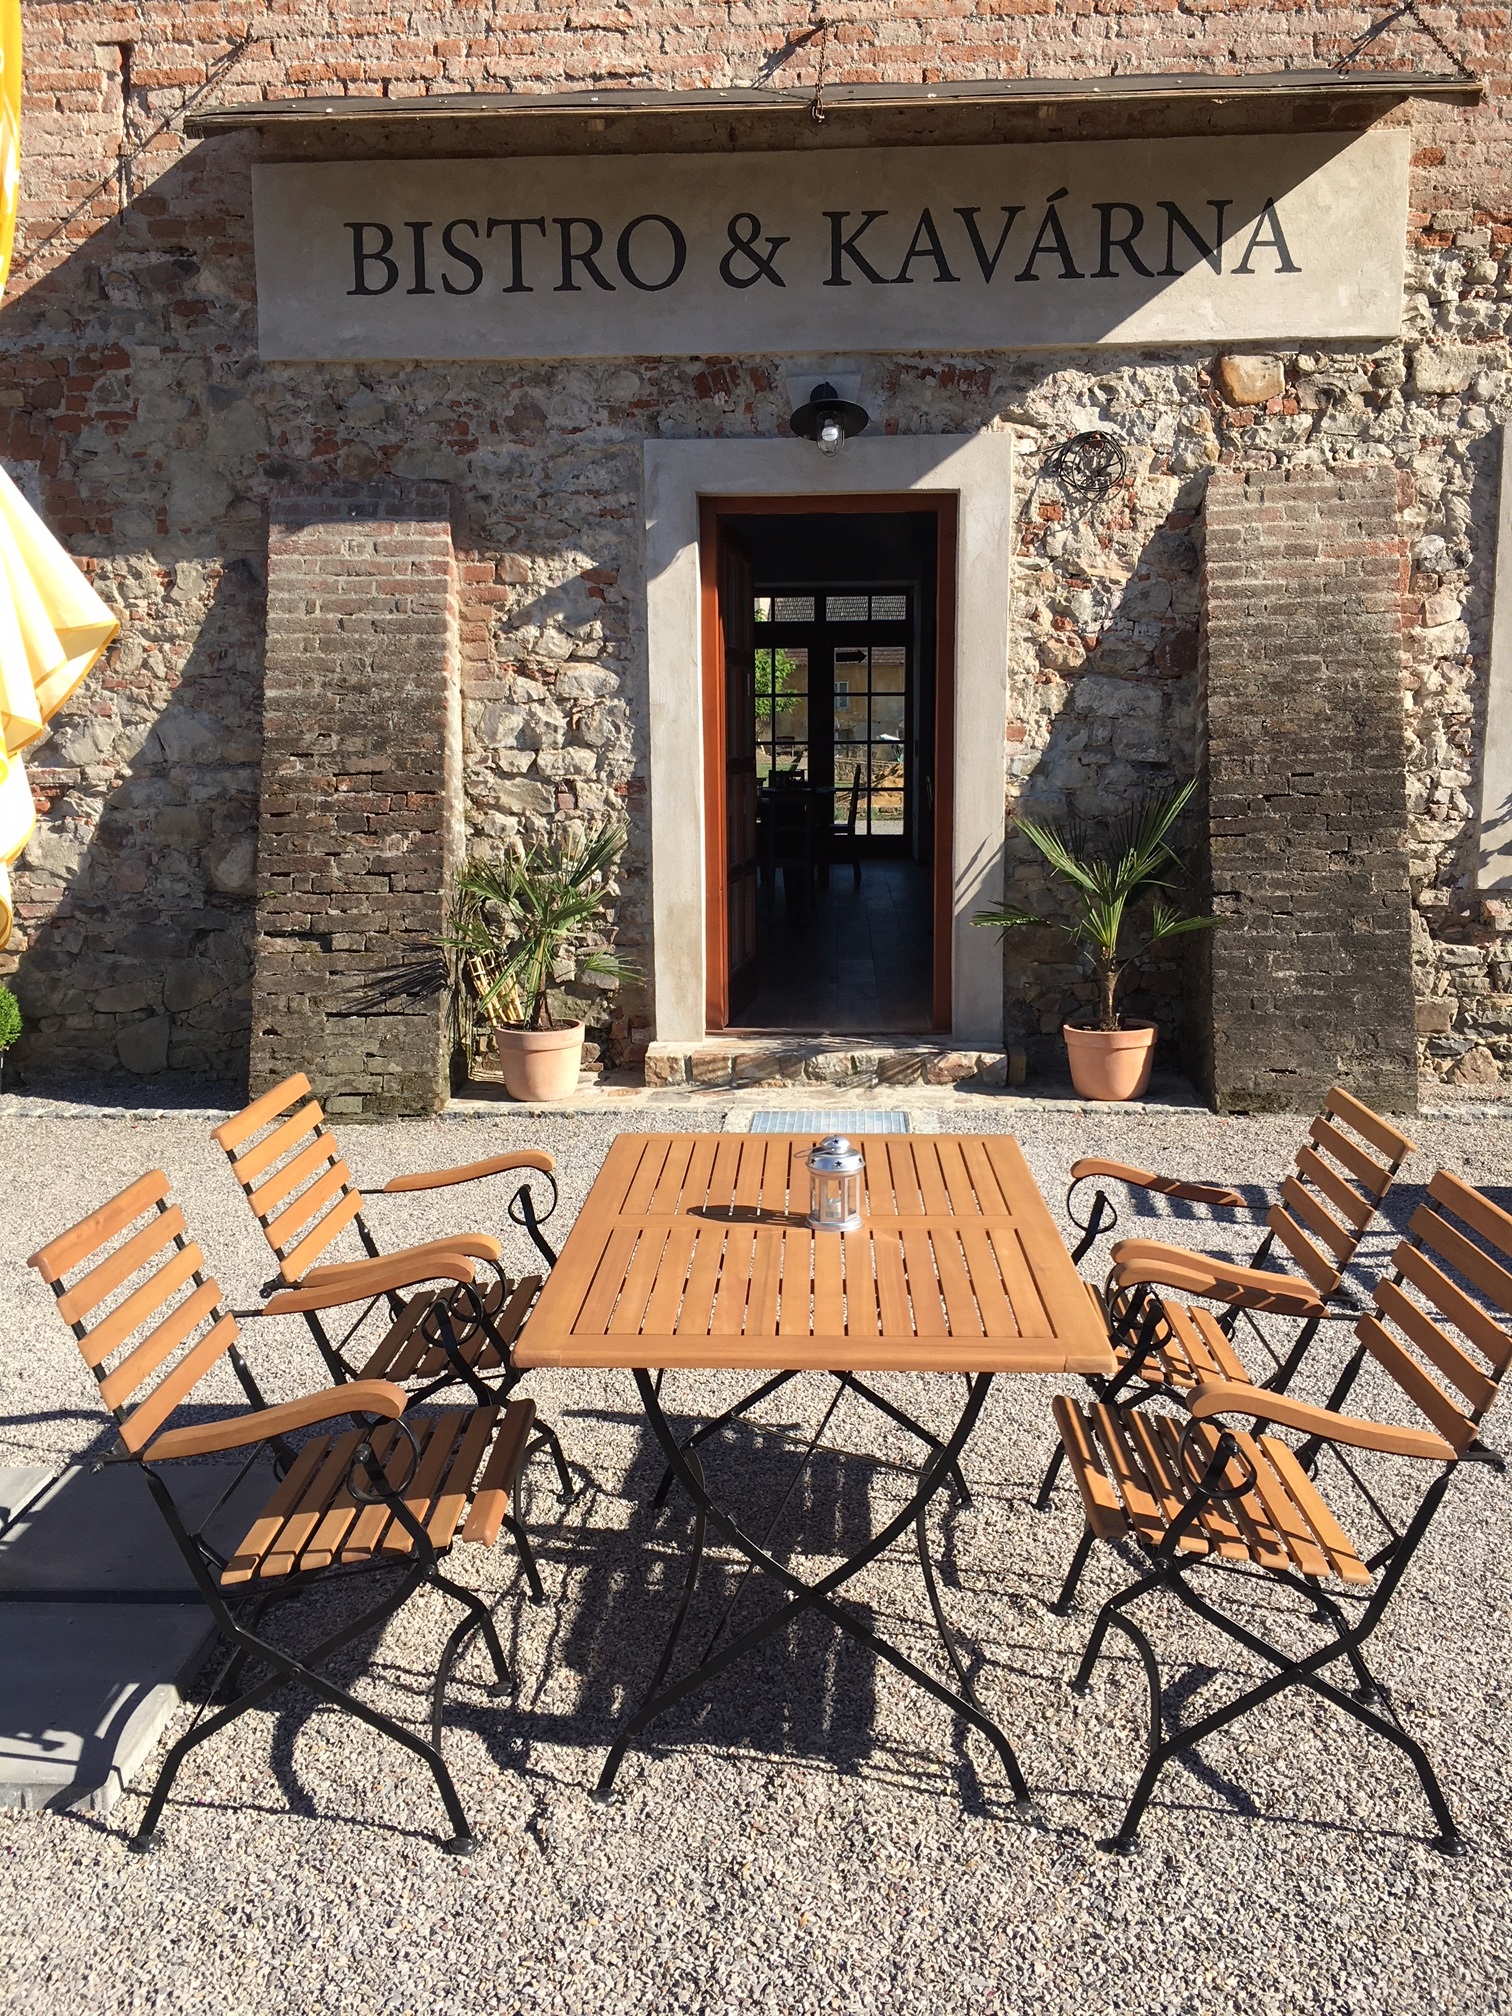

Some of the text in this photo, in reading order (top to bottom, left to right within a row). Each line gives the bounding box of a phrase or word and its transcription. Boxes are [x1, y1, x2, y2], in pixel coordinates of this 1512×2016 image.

[343, 187, 1302, 296] BISTRO & KAVÁRNA
